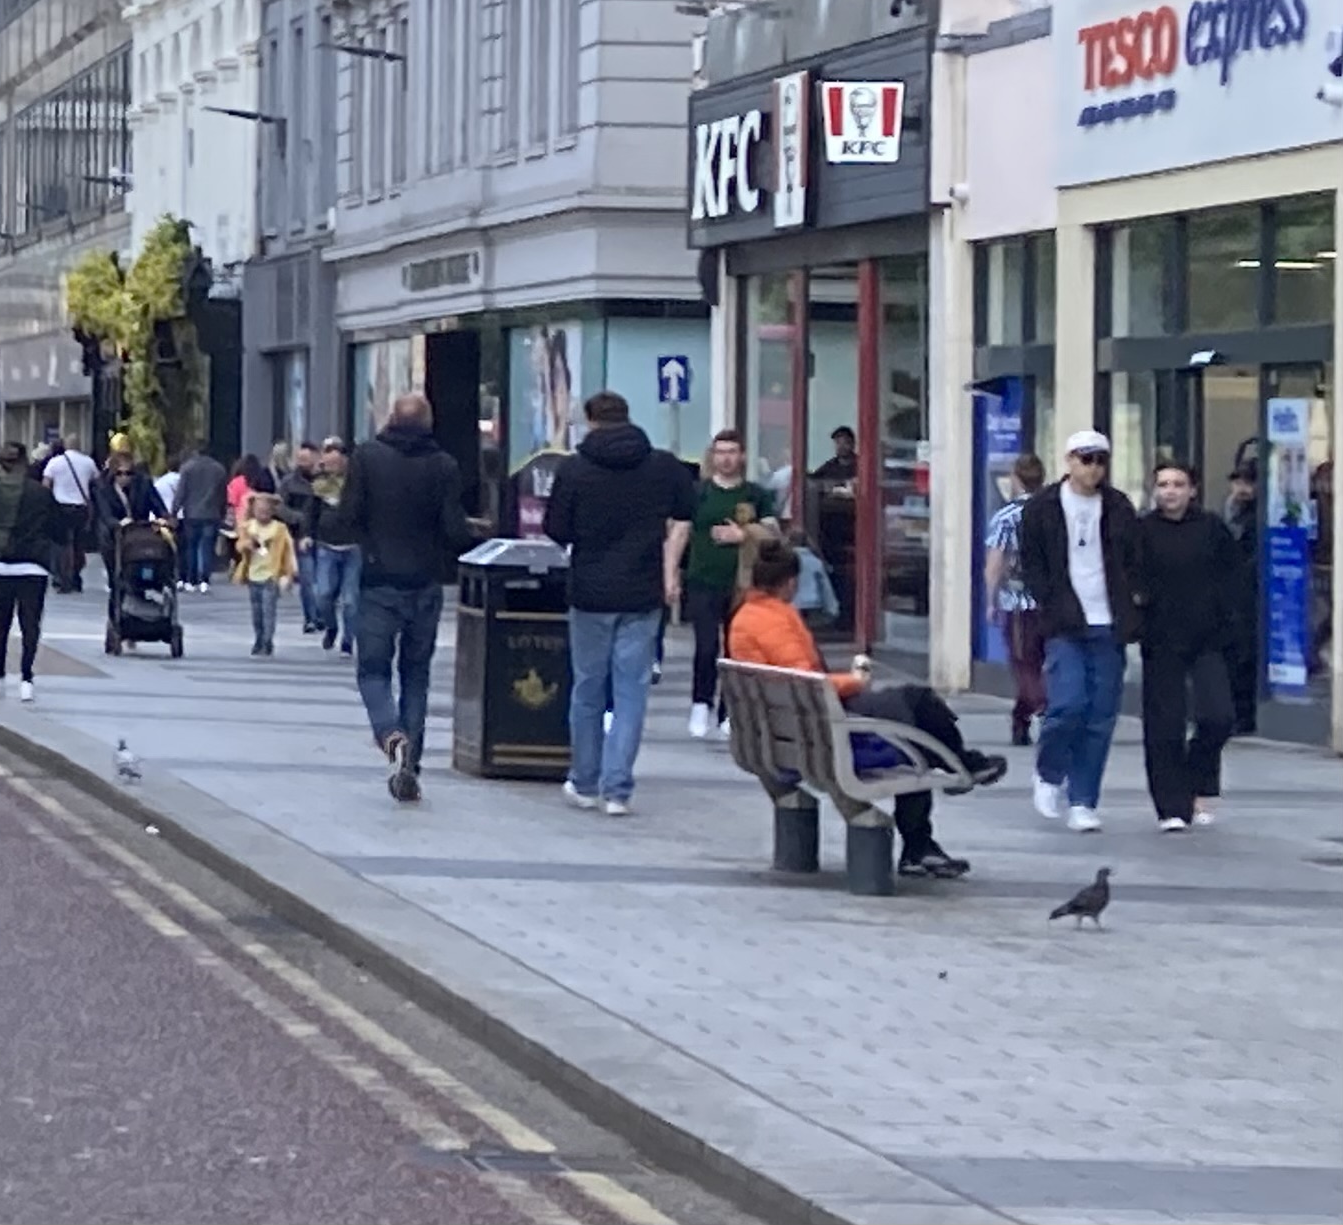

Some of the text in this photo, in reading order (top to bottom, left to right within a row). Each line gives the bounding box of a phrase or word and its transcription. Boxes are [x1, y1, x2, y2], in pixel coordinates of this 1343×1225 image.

[1077, 5, 1180, 91] TESCO
[690, 108, 762, 221] KFC
[840, 139, 888, 156] KFC
